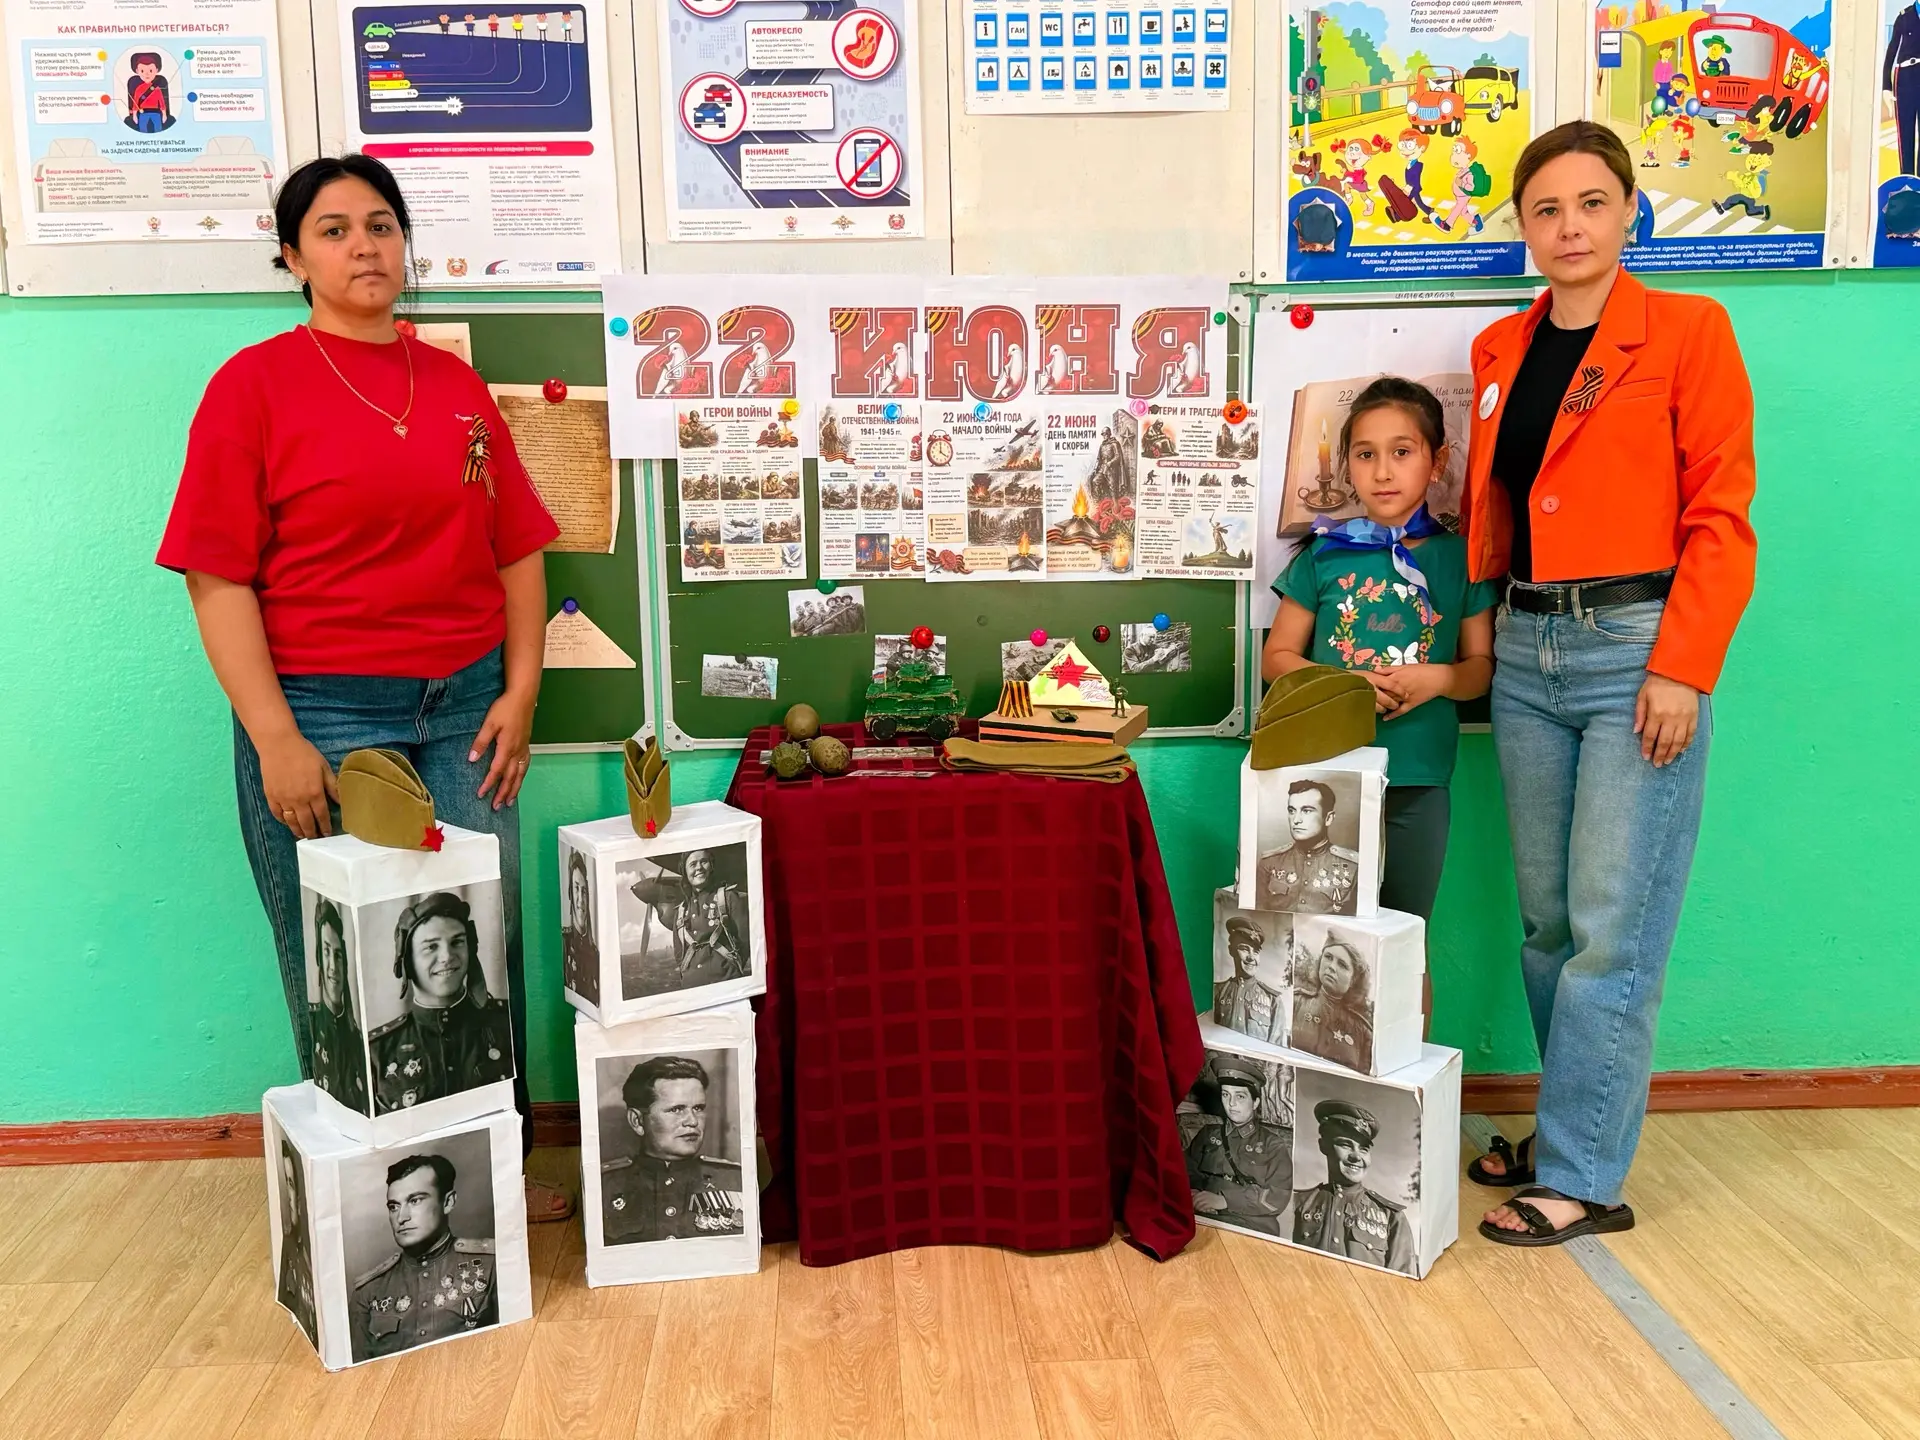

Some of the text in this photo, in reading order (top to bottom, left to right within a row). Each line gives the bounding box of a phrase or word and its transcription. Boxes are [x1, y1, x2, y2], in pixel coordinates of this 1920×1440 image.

[1411, 0, 1451, 8] Светофор
[57, 24, 230, 34] КАК ПРАВИЛЬНО ПРИСТЕГИВАТЬСЯ?
[1462, 25, 1494, 33] переход!
[751, 91, 828, 99] ПРЕДСКАЗУЕМОСТЬ
[632, 302, 1211, 403] 22 ИЮНЯ
[1338, 389, 1353, 403] 22
[704, 405, 772, 418] ГЕРОИ ВОЙНЫ
[1148, 407, 1177, 416] ПТЕРИ
[1180, 406, 1186, 416] И
[896, 415, 919, 424] ВОЙНА
[943, 412, 954, 423] 22
[1004, 413, 1022, 422] ГОДА
[1048, 415, 1097, 428] 22 ИЮНЯ
[952, 424, 1011, 435] НАЧАЛО ВОЙНЫ
[1048, 430, 1097, 440] ДЕНЬ ПАМЯТИ
[1055, 442, 1089, 450] И СКОРБИ
[1366, 612, 1407, 633] hello
